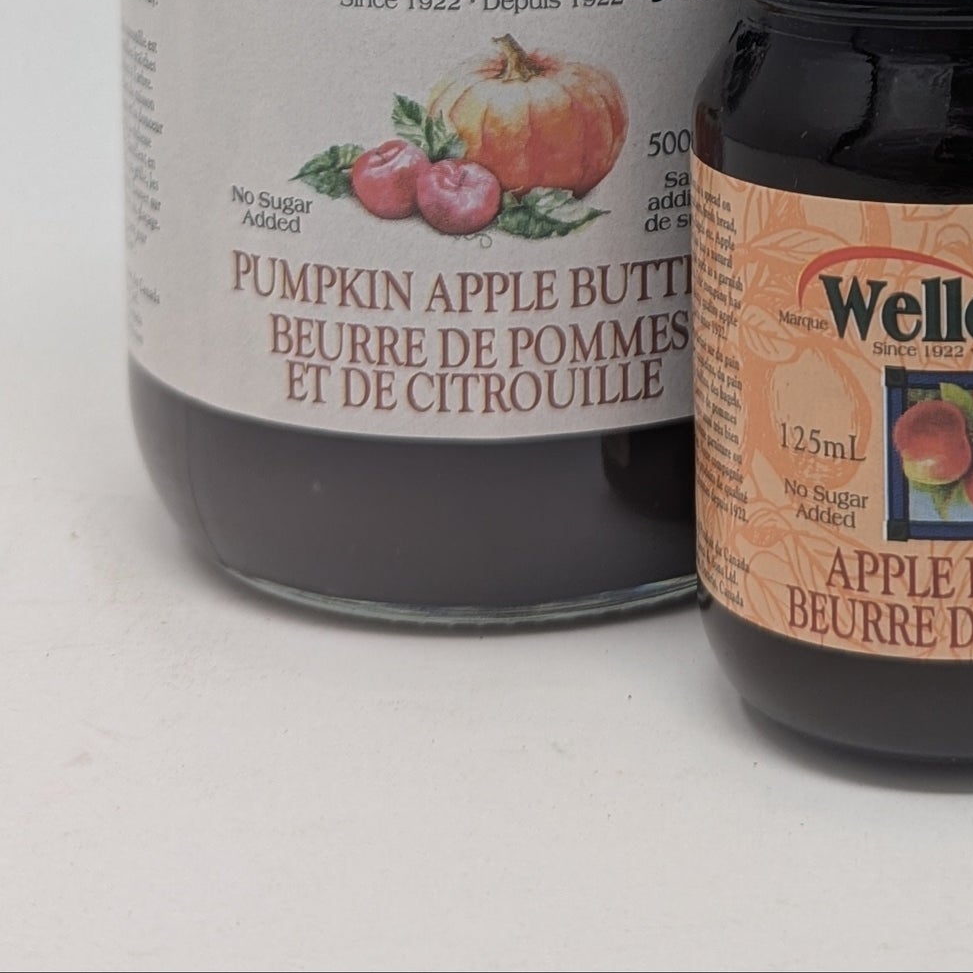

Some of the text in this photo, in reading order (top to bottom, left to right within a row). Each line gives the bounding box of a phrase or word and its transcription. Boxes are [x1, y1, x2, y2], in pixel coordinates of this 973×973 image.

[648, 128, 692, 157] 500
[664, 171, 690, 189] Sa
[231, 184, 313, 215] No Sugar
[648, 190, 691, 211] addi
[242, 209, 301, 233] Added
[644, 213, 692, 233] de s
[232, 249, 414, 311] PUMPKIN
[425, 269, 559, 314] APPLE
[778, 309, 829, 332] Marque
[270, 313, 428, 369] BEURRE
[438, 327, 498, 369] DE
[508, 310, 690, 369] POMMES
[872, 341, 917, 357] Since
[924, 344, 964, 358] 1922
[286, 359, 331, 404] ET
[341, 366, 397, 411] DE
[406, 358, 665, 413] CITROUILLE
[780, 423, 867, 462] 125mL
[784, 478, 869, 510] No Sugar
[796, 502, 856, 528] Added
[723, 547, 750, 574] Canada
[825, 545, 956, 599] APPLE
[786, 583, 938, 648] BEURRE
